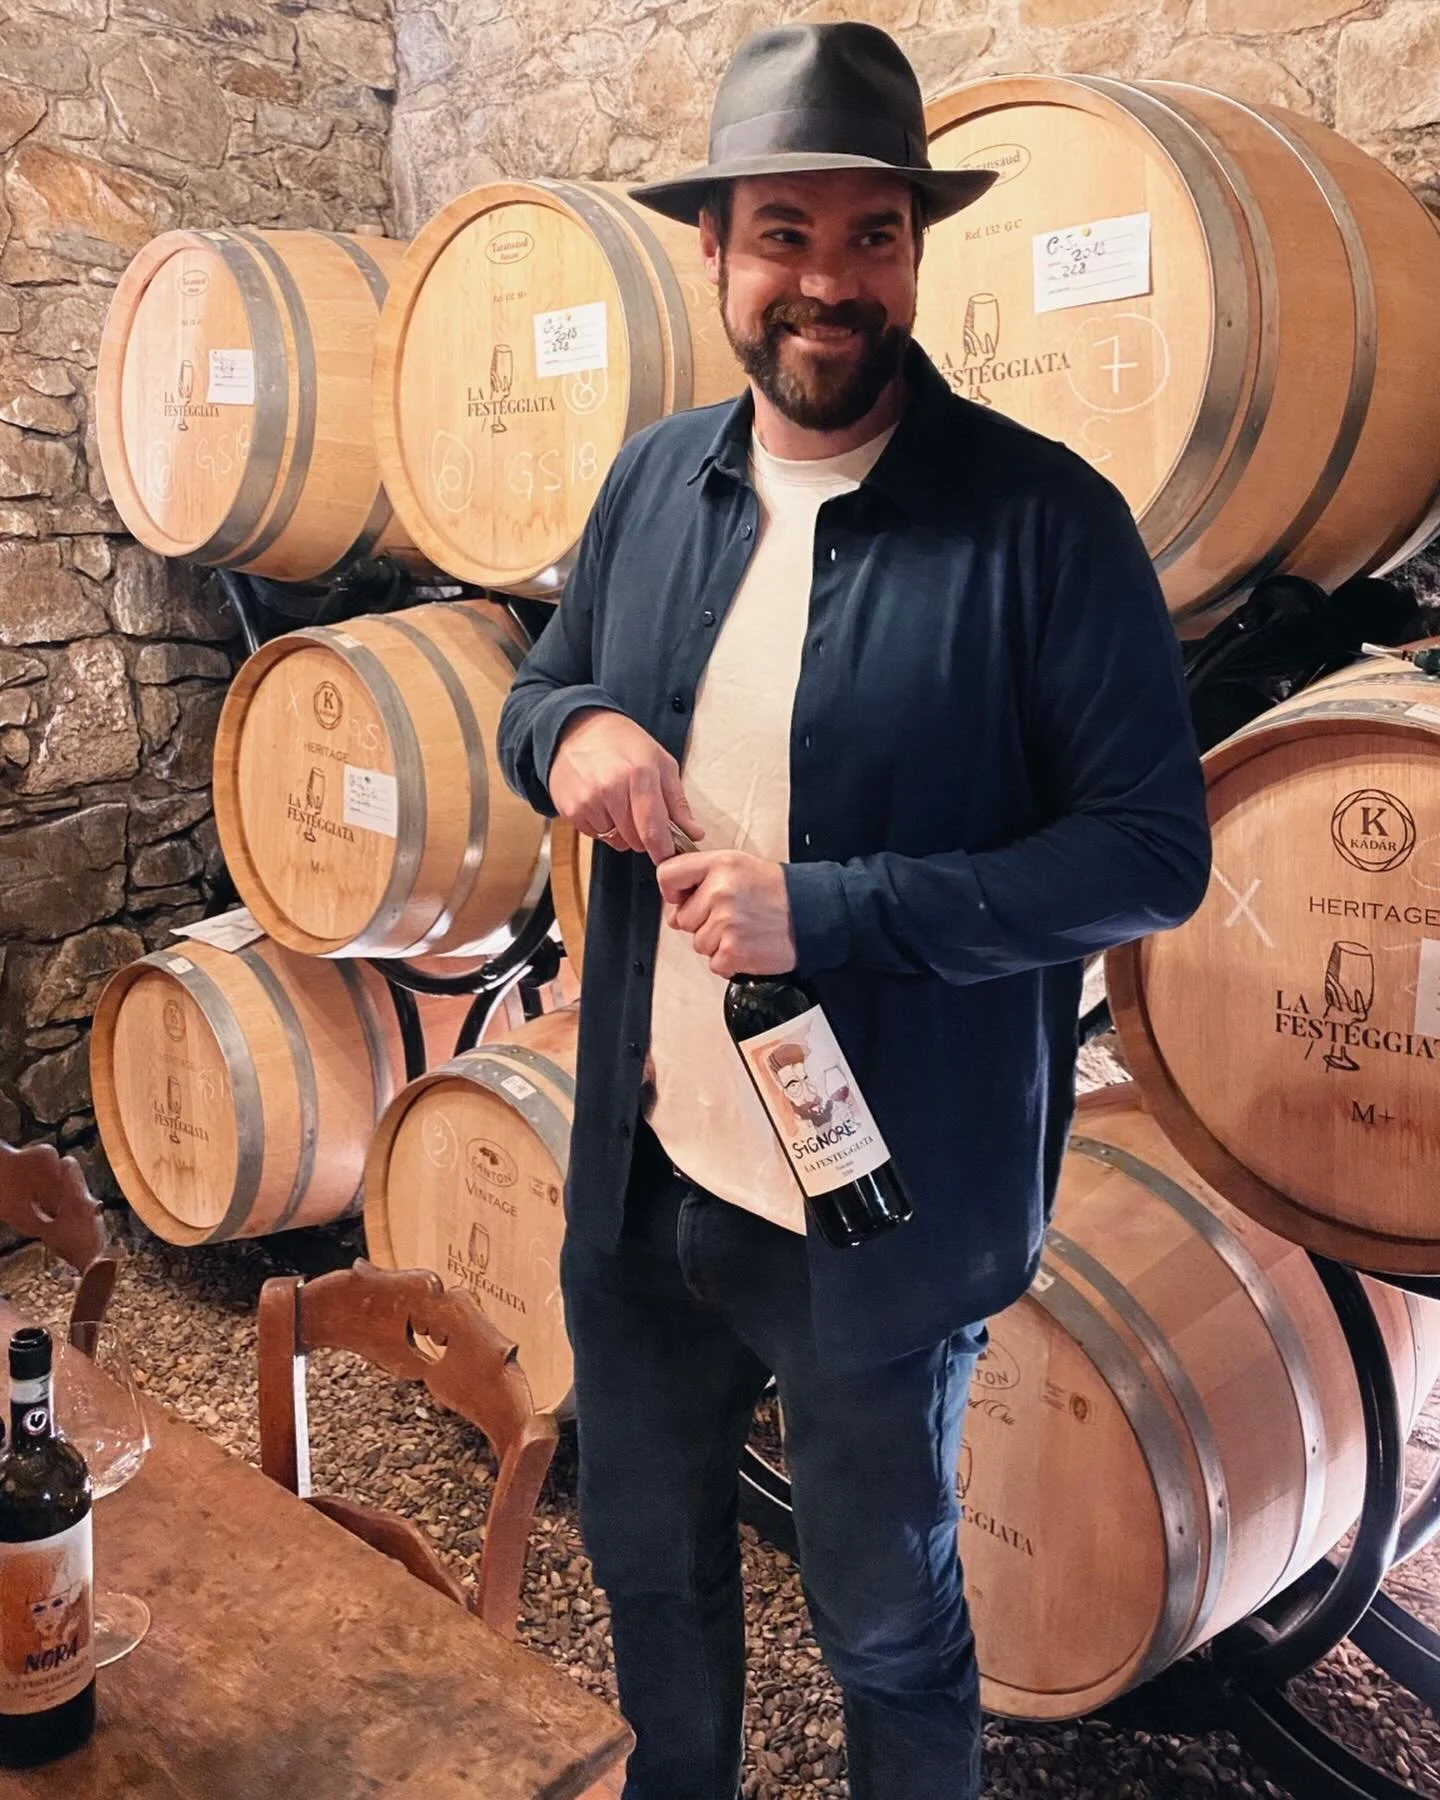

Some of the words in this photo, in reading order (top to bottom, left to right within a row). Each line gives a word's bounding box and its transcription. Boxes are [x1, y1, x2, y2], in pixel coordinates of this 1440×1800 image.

[942, 351, 1072, 389] STEGGIATA
[467, 386, 485, 402] LA
[467, 396, 556, 418] FESTEGGIATA
[287, 792, 302, 809] LA
[1360, 806, 1389, 837] K
[1349, 837, 1398, 852] KÁDÁR
[1309, 895, 1440, 928] HERITAGE
[1275, 989, 1310, 1016] LA
[1275, 1013, 1440, 1060] FESTEGGIA
[1351, 1100, 1396, 1126] M+
[975, 1367, 1009, 1385] TON
[960, 1503, 1035, 1558] GGIATA
[23, 1633, 78, 1675] NORA
